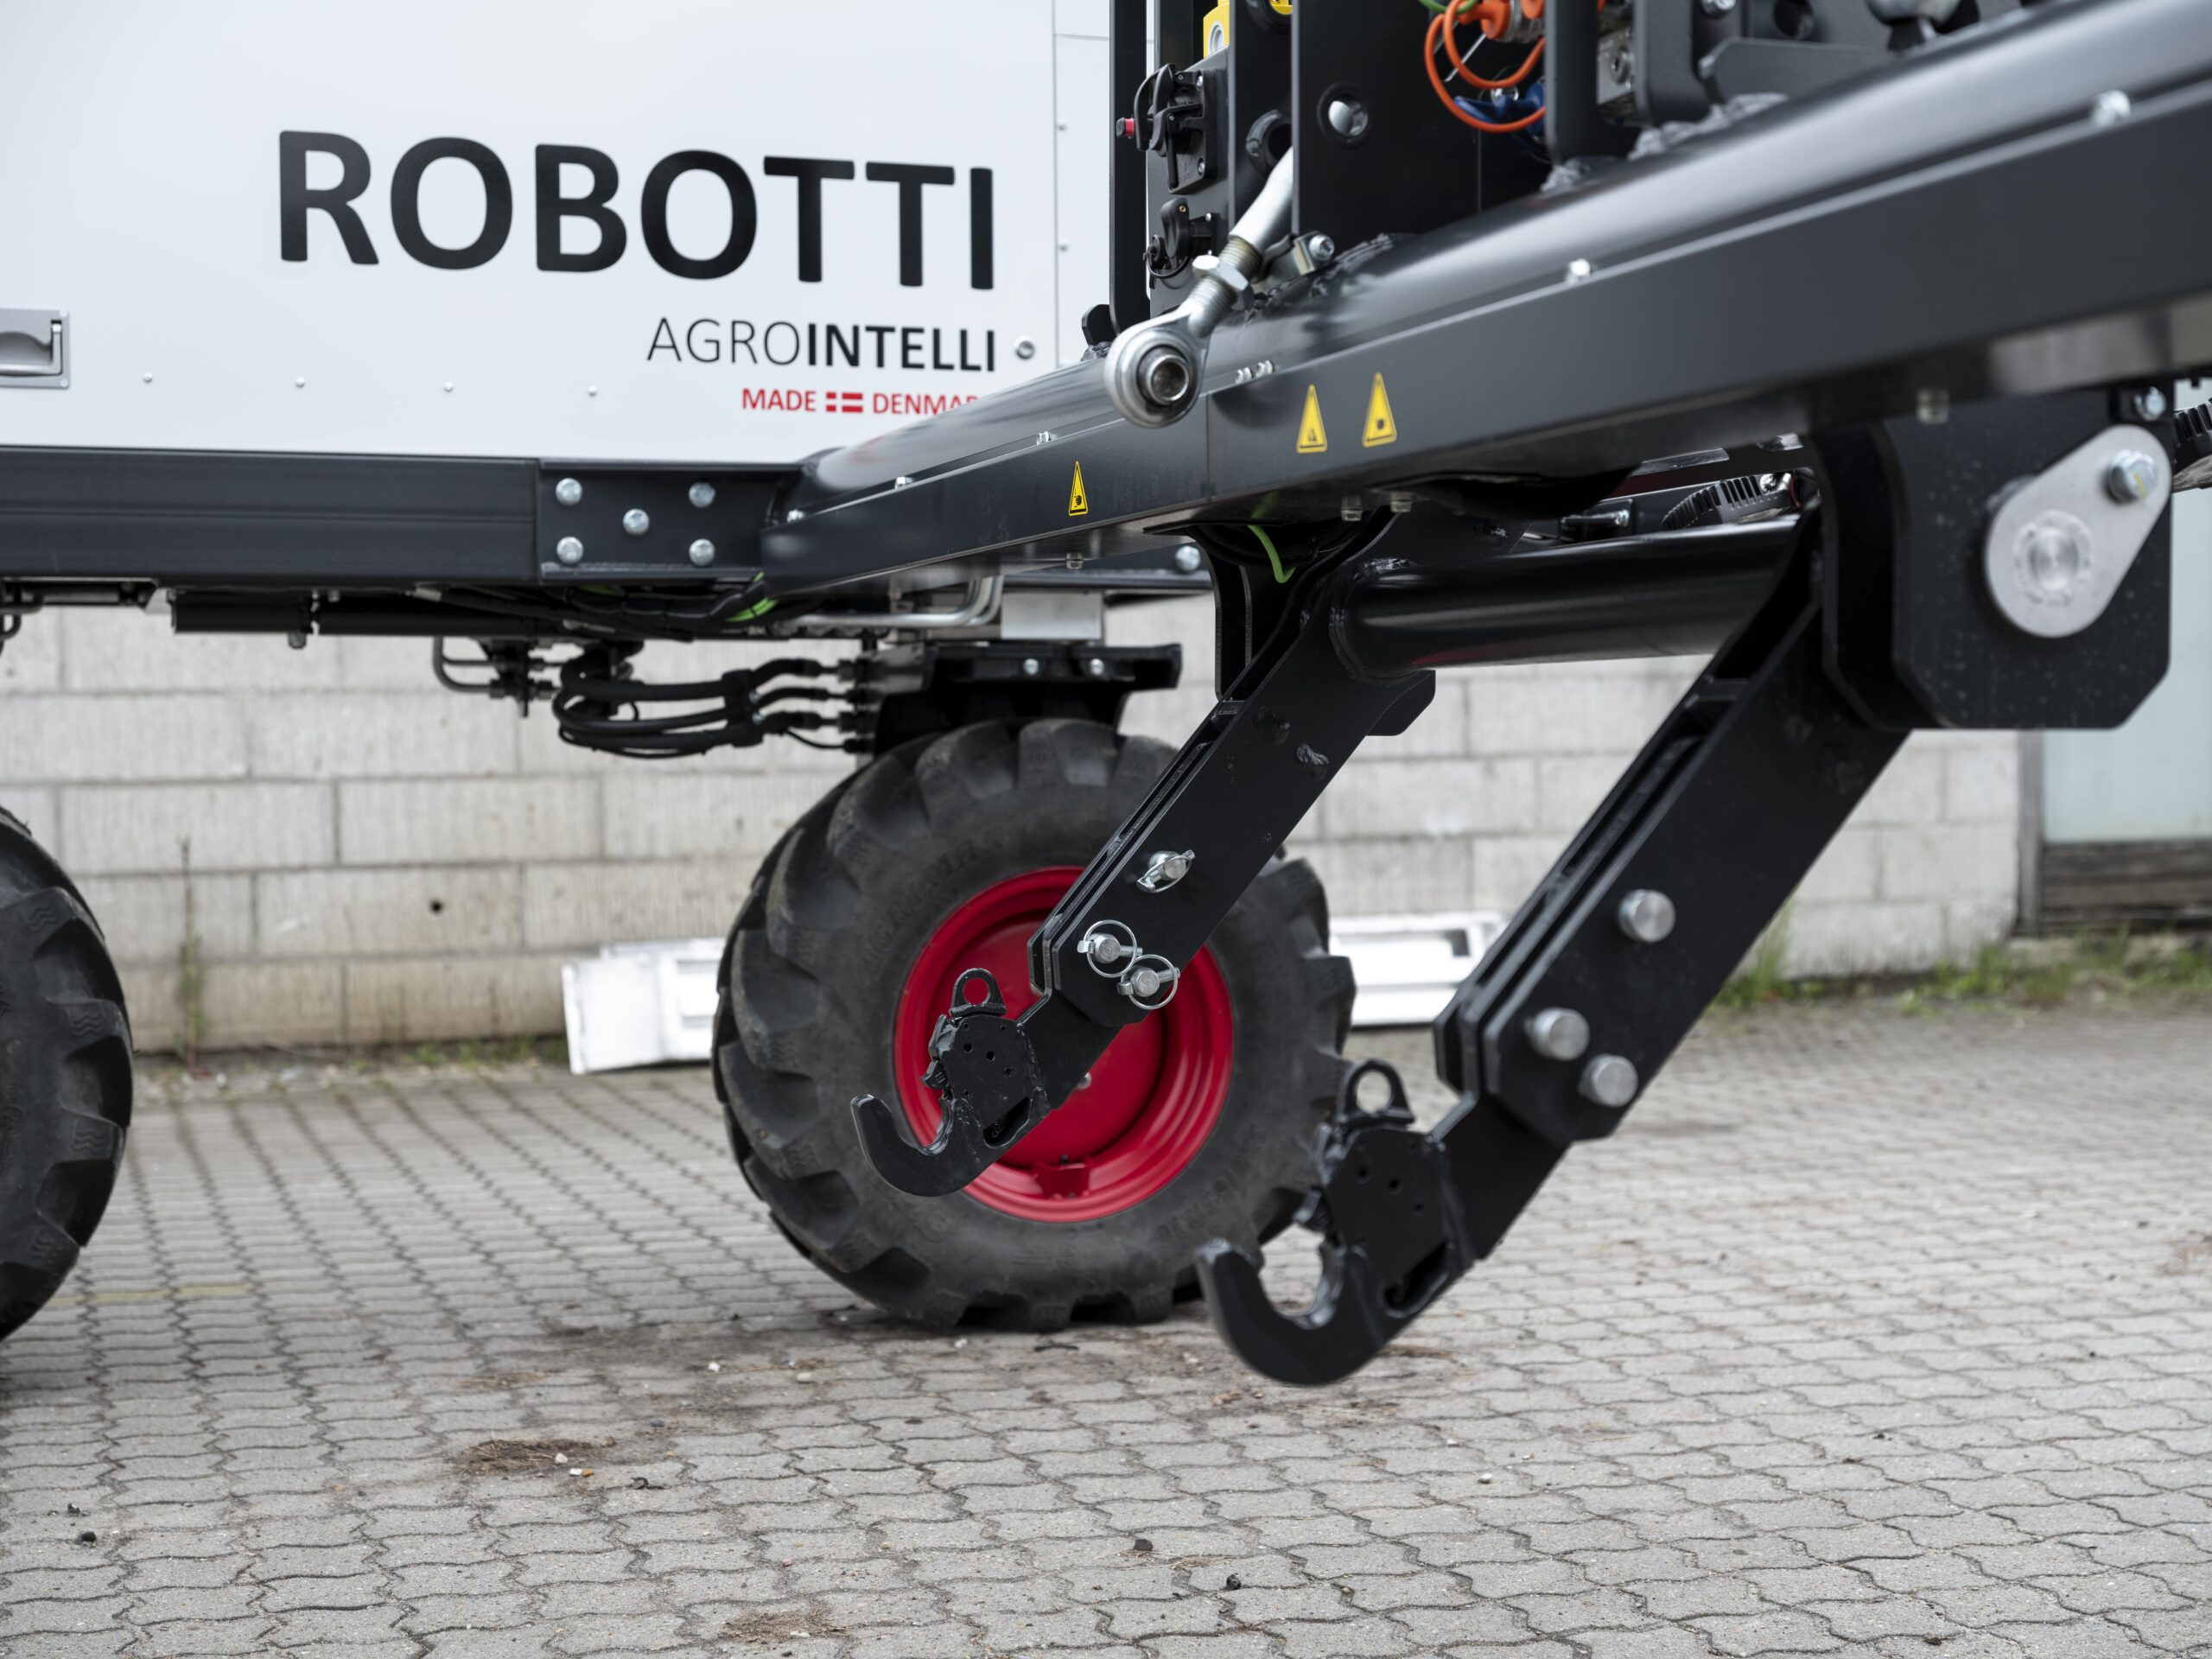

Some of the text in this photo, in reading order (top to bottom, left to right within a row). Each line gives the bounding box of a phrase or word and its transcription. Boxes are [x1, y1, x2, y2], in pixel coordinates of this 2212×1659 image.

[279, 130, 994, 290] ROBOTTI
[646, 317, 995, 372] AGROINTELLI
[741, 387, 977, 416] MADE DENMA
